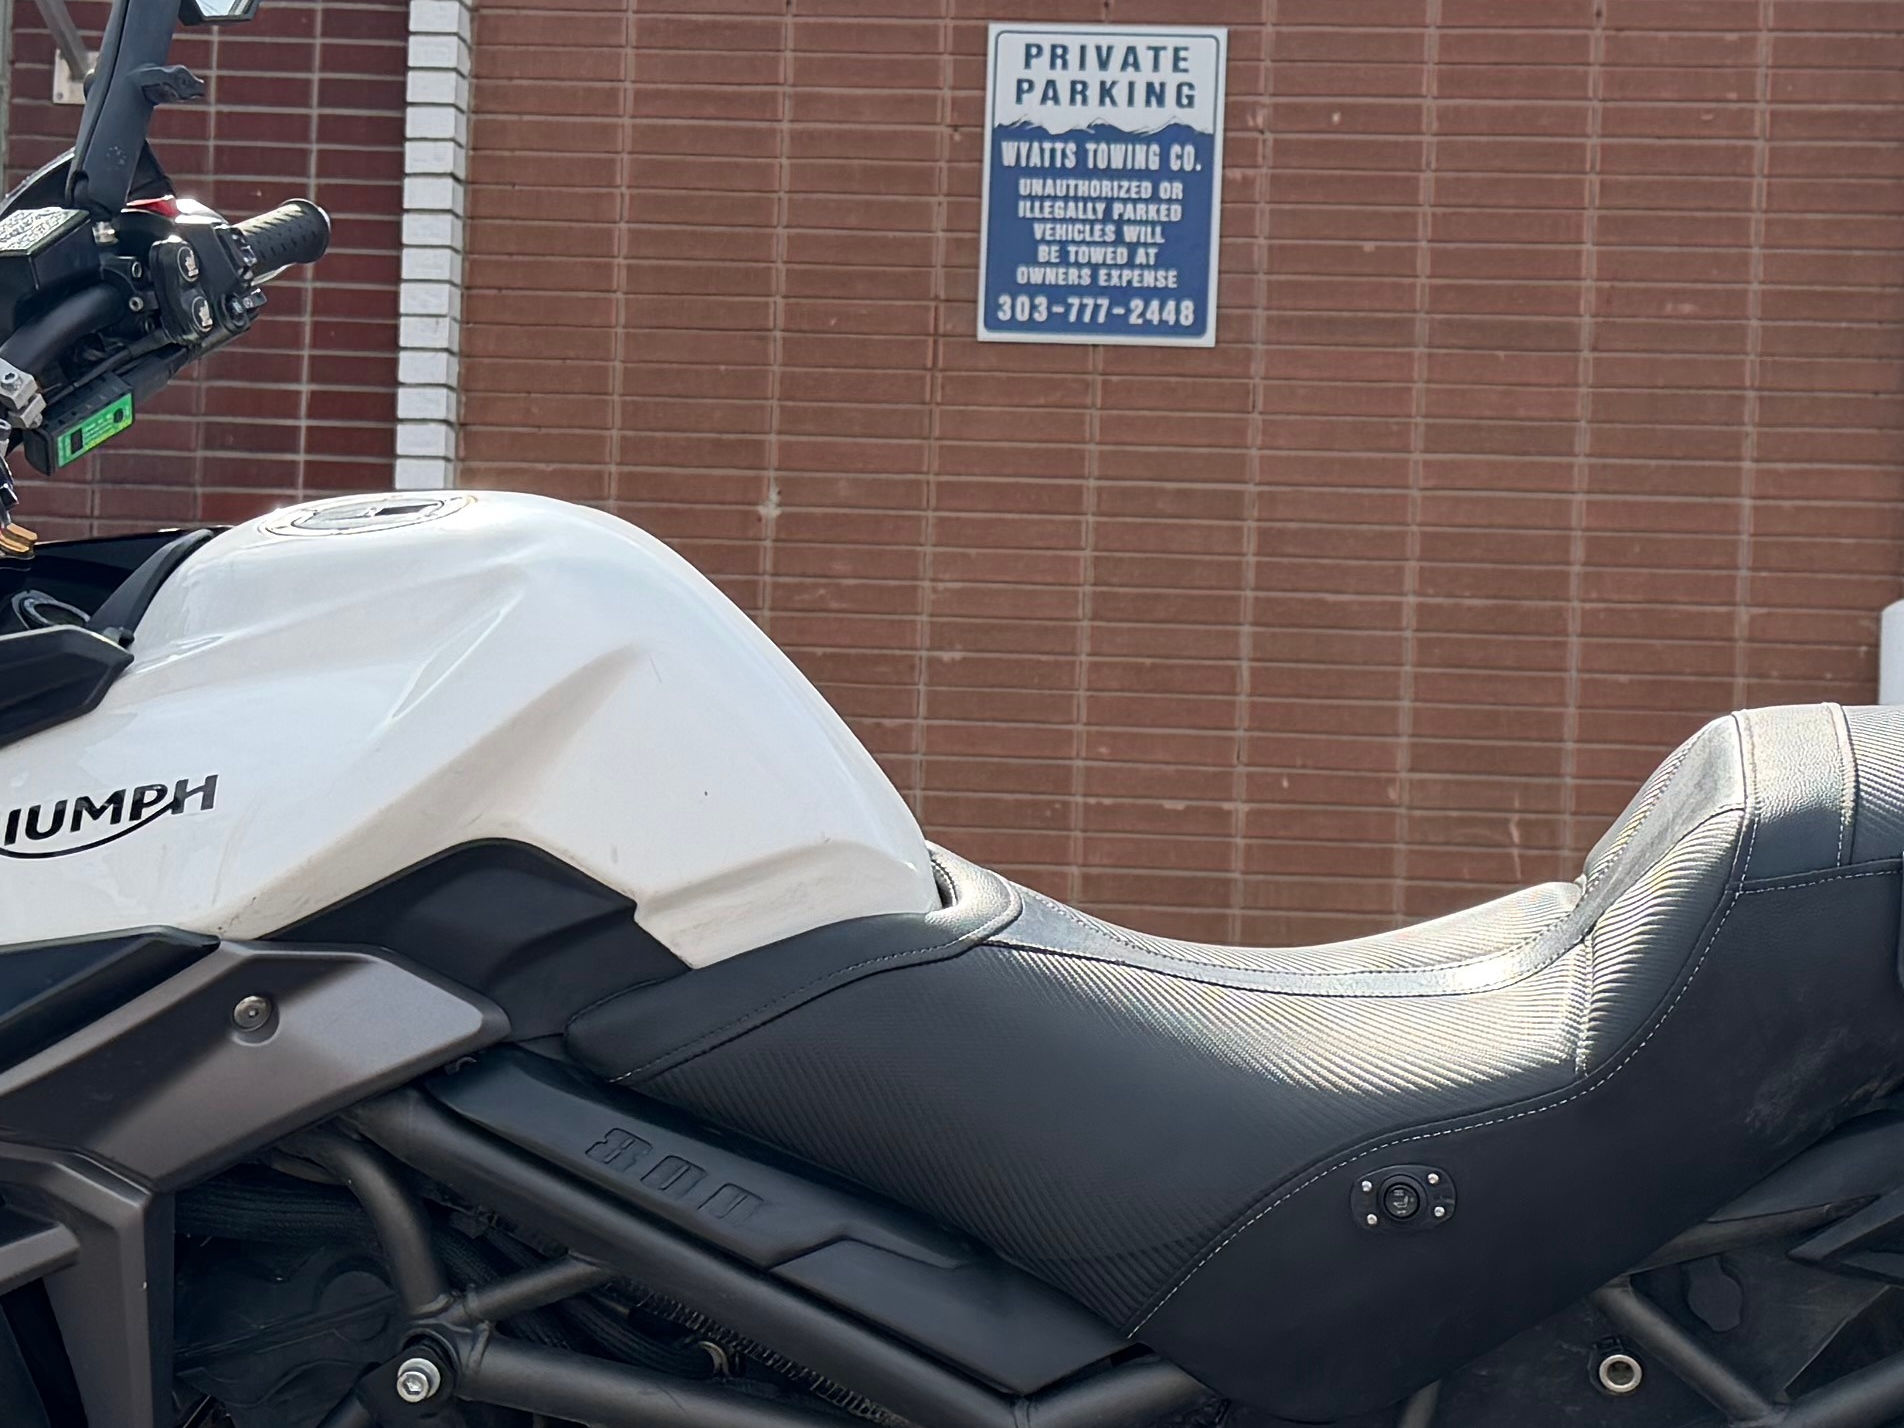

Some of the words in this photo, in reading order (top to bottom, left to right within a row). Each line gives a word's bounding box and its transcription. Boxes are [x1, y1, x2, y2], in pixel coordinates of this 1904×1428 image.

[1023, 43, 1191, 73] PRIVATE
[1014, 78, 1196, 109] PARKING
[1001, 141, 1077, 169] WYATTS
[1085, 143, 1161, 171] TOWING
[1169, 144, 1202, 172] CO.
[1018, 178, 1153, 199] UNAUTHORIZED
[1159, 181, 1184, 199] OR
[1017, 200, 1106, 220] ILLEGALLY
[1112, 203, 1183, 222] PARKED
[1033, 223, 1116, 242] VEHICLES
[1123, 225, 1166, 244] WILL
[1037, 245, 1061, 263] BE
[1067, 246, 1129, 265] TOWED
[1134, 247, 1159, 266] AT
[1016, 266, 1092, 286] OWNERS
[1098, 269, 1178, 289] EXPENSE
[997, 294, 1195, 326] 303-777-2448
[584, 1127, 766, 1223] 800
